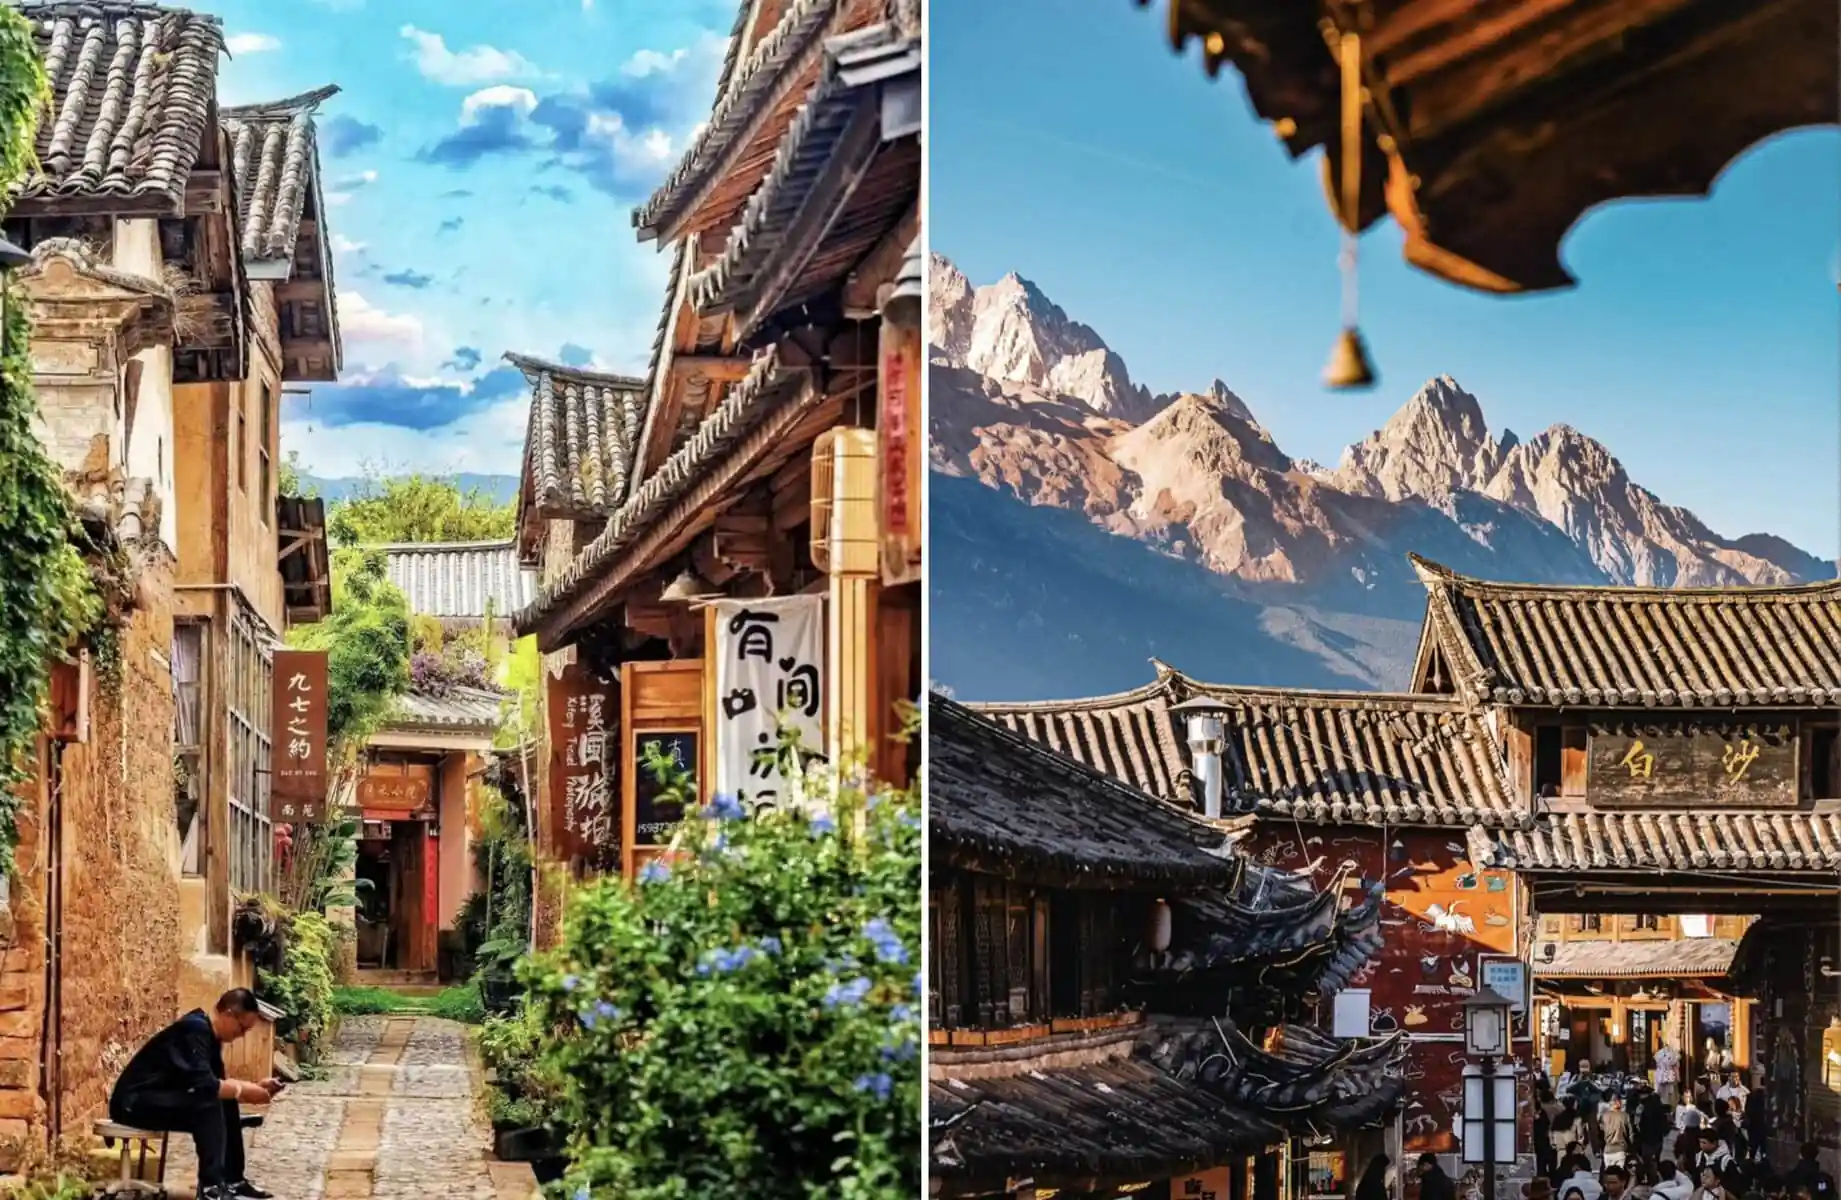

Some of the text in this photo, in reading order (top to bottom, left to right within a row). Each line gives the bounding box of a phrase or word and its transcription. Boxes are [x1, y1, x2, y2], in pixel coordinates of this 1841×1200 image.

[287, 672, 312, 759] 九七之約
[1619, 739, 1761, 786] 白沙
